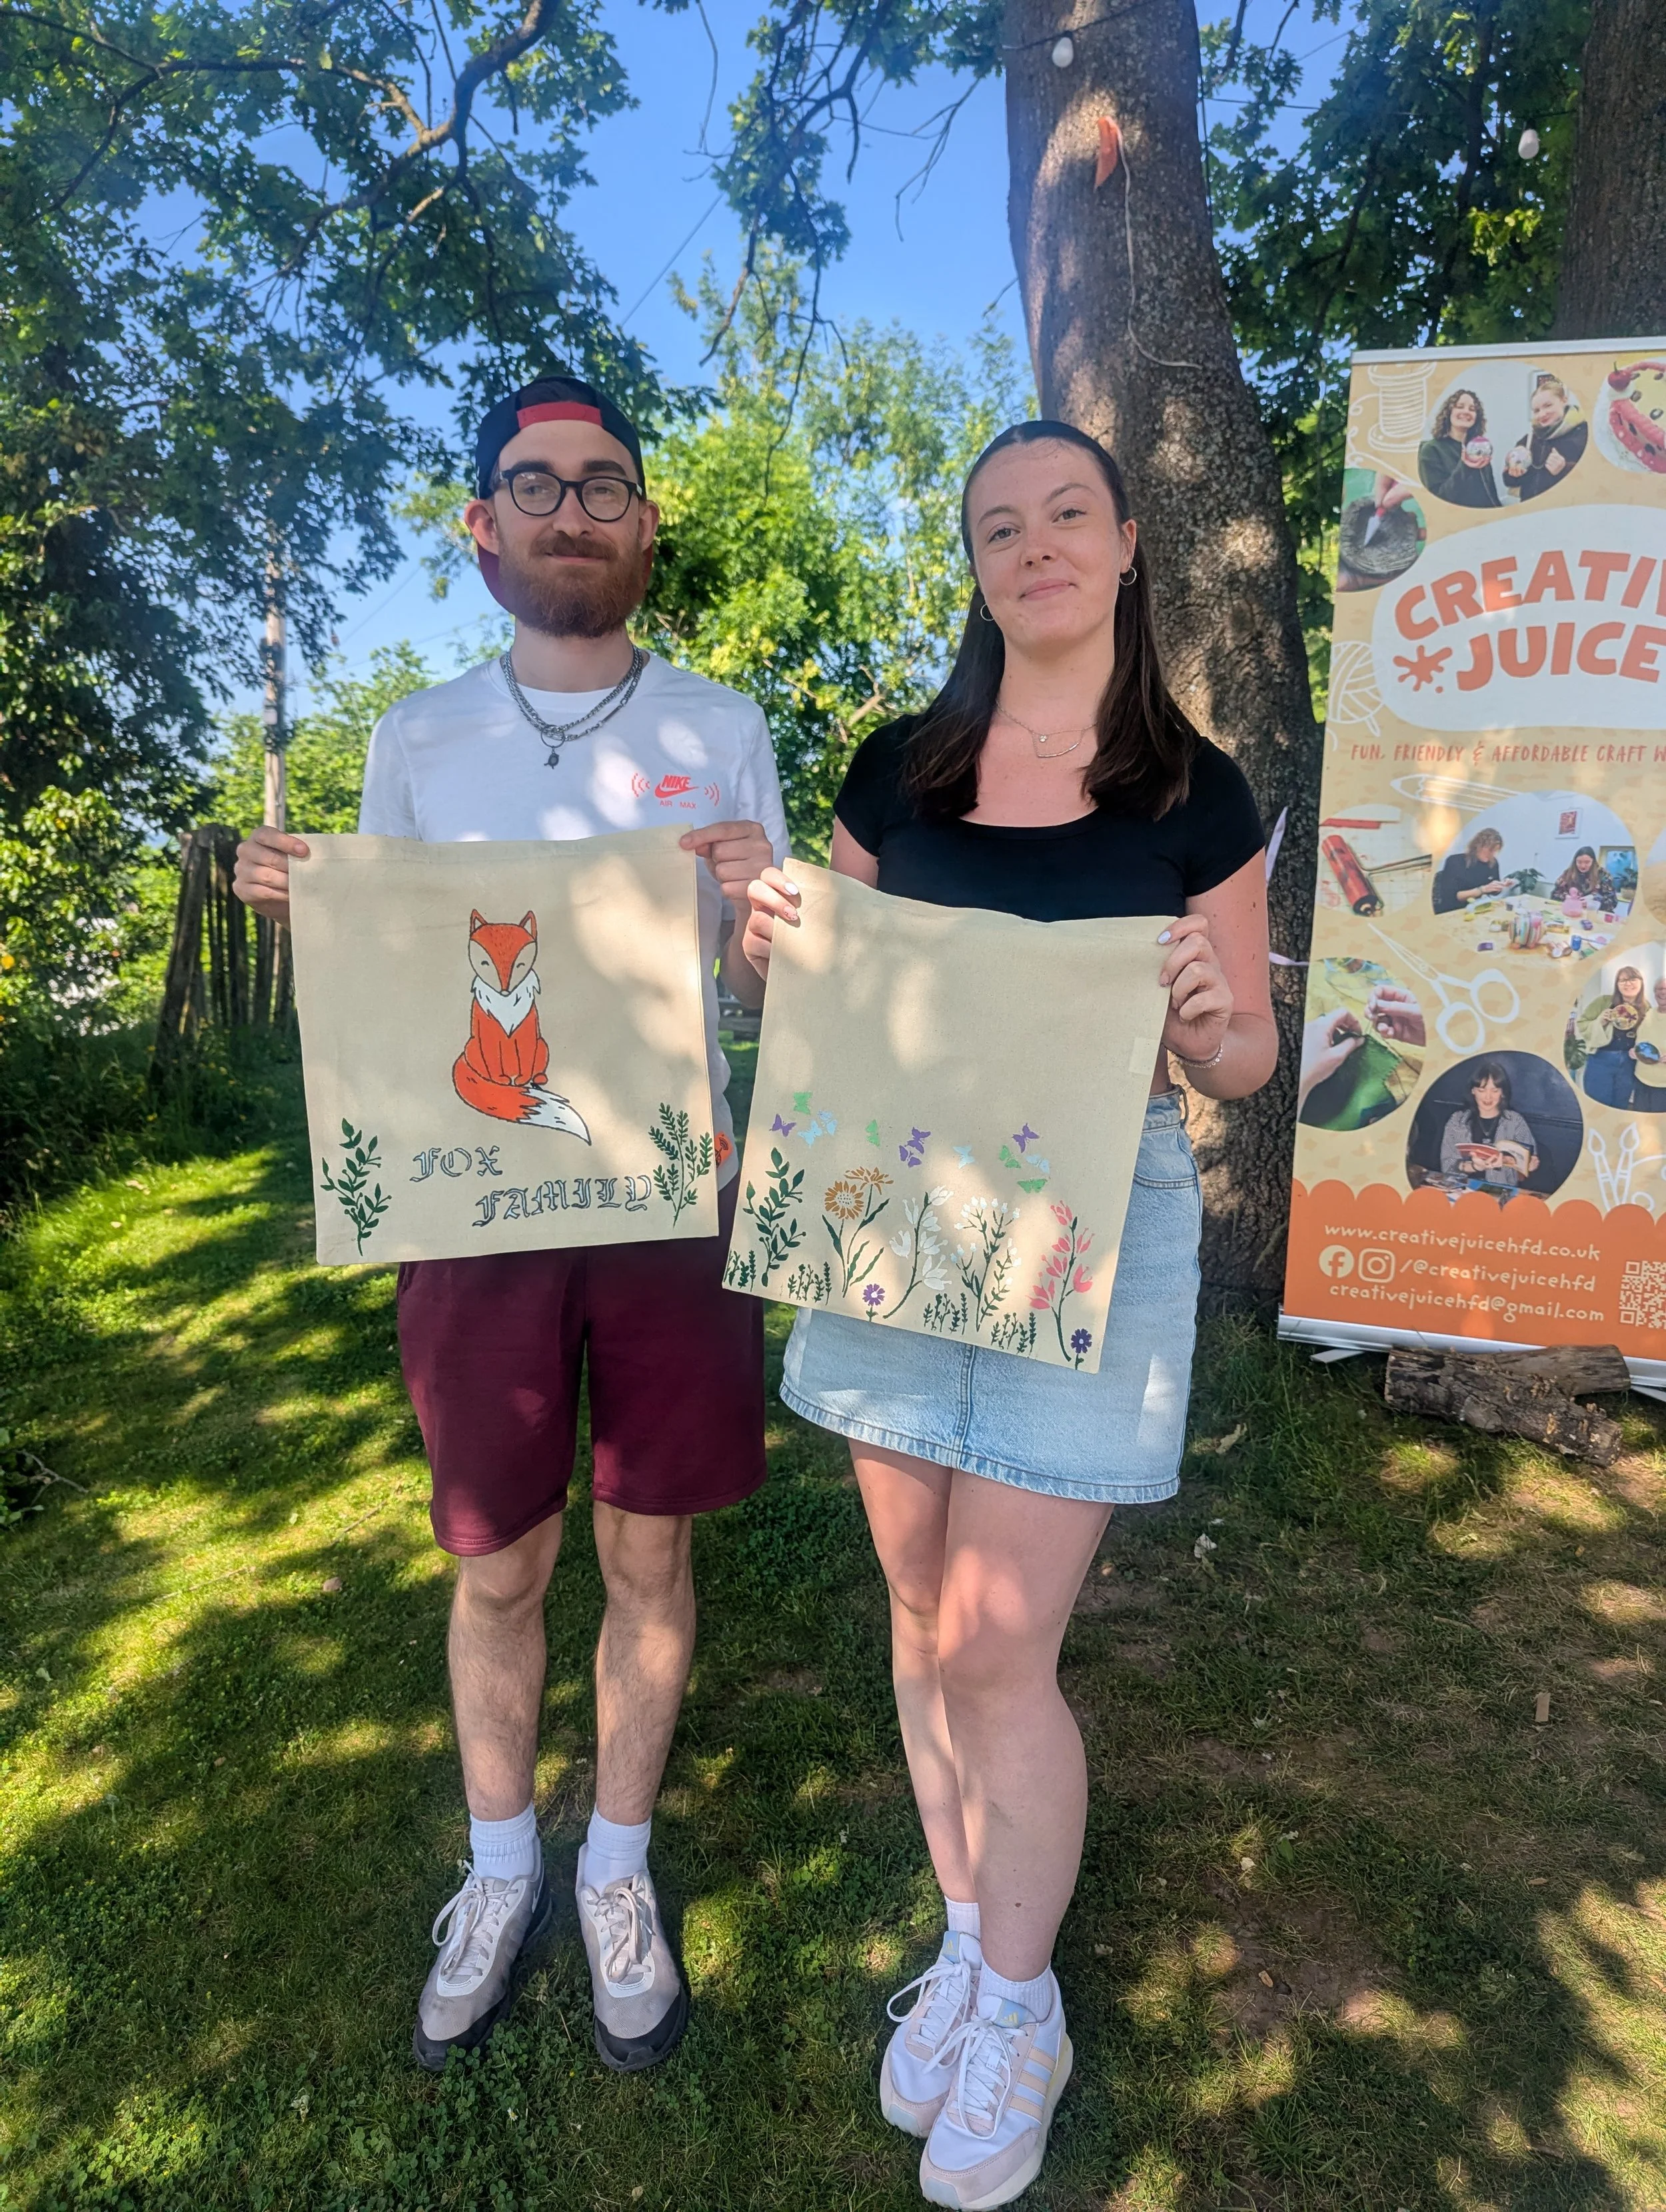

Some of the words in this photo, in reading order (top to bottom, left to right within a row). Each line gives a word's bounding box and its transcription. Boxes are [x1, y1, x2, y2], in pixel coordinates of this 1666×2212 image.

[1394, 550, 1666, 641] CREATI
[1456, 622, 1666, 692] JUICE
[1393, 744, 1465, 762] FRIENDLY
[1473, 740, 1485, 766] &
[1492, 744, 1589, 762] AFFORDABLE
[1596, 744, 1647, 762] CRAFT
[661, 775, 691, 789] NIKE
[409, 1145, 503, 1183] FOX
[472, 1175, 652, 1227] FAMILY
[1324, 1225, 1601, 1261] www.creativejuicehfd.co.uk
[1399, 1259, 1596, 1292] /@creativejuicehfd
[1329, 1284, 1604, 1323] creativejuicehfd@gmail.com
